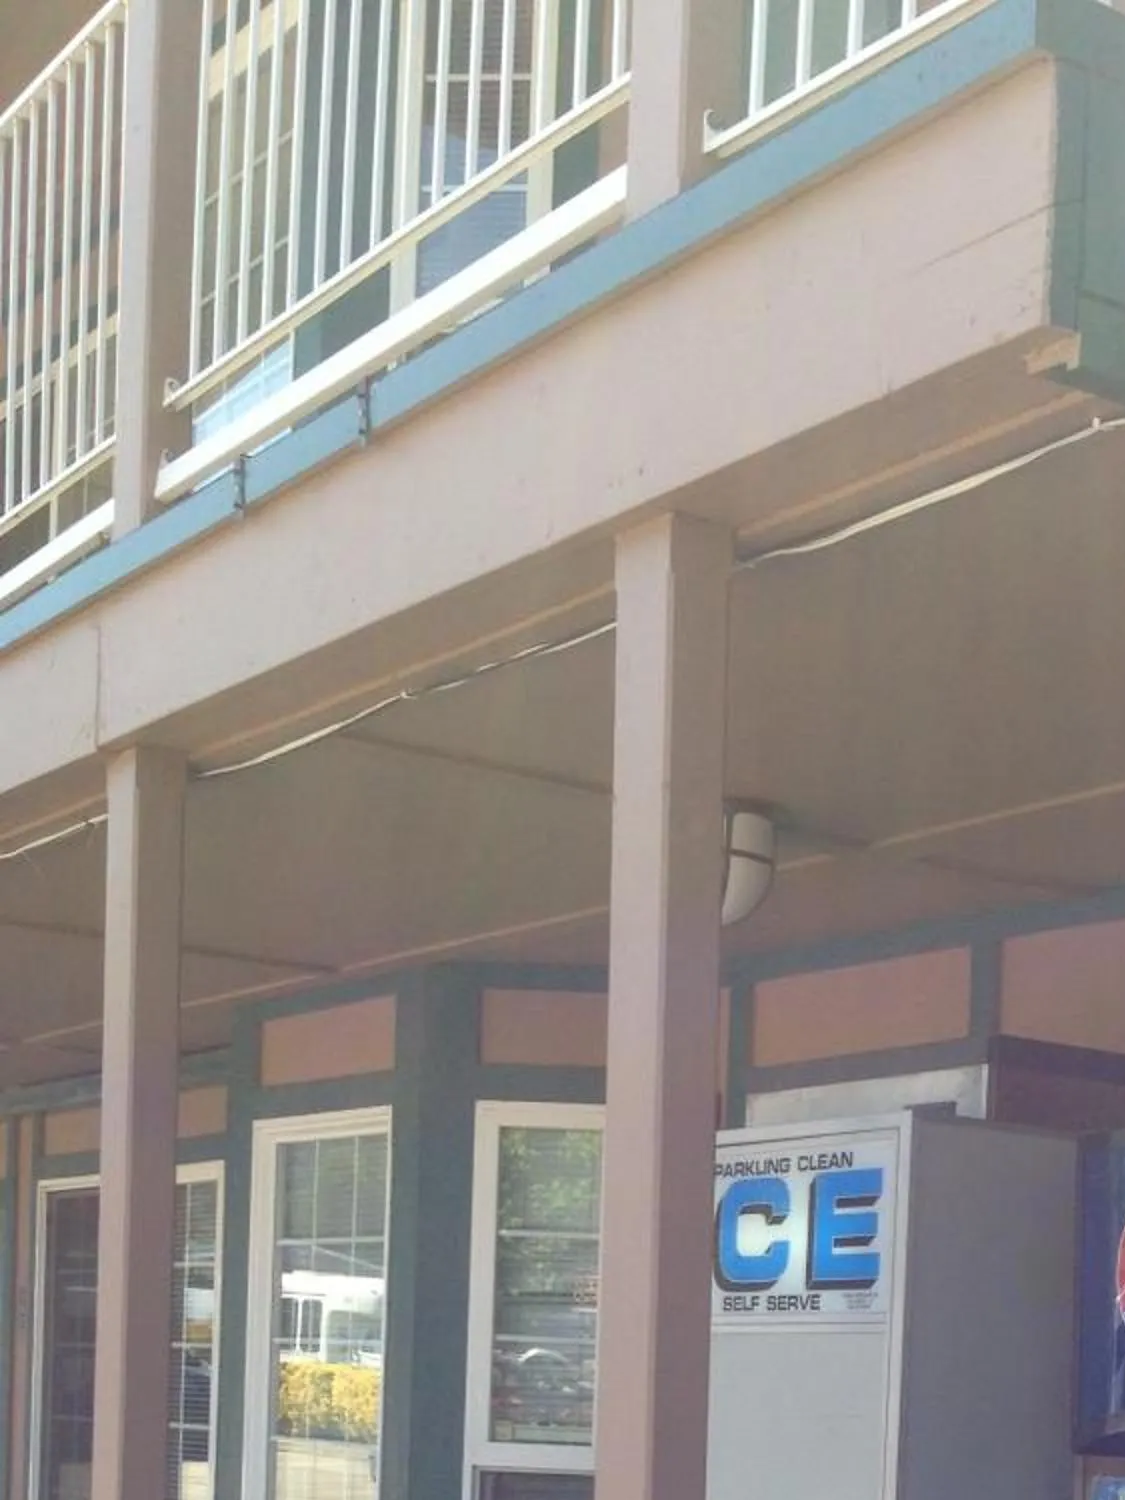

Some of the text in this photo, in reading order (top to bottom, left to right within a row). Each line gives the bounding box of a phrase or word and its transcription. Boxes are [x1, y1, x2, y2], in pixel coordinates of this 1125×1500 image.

[797, 1151, 853, 1171] CLEAN
[722, 1294, 821, 1312] SELF SERVE
